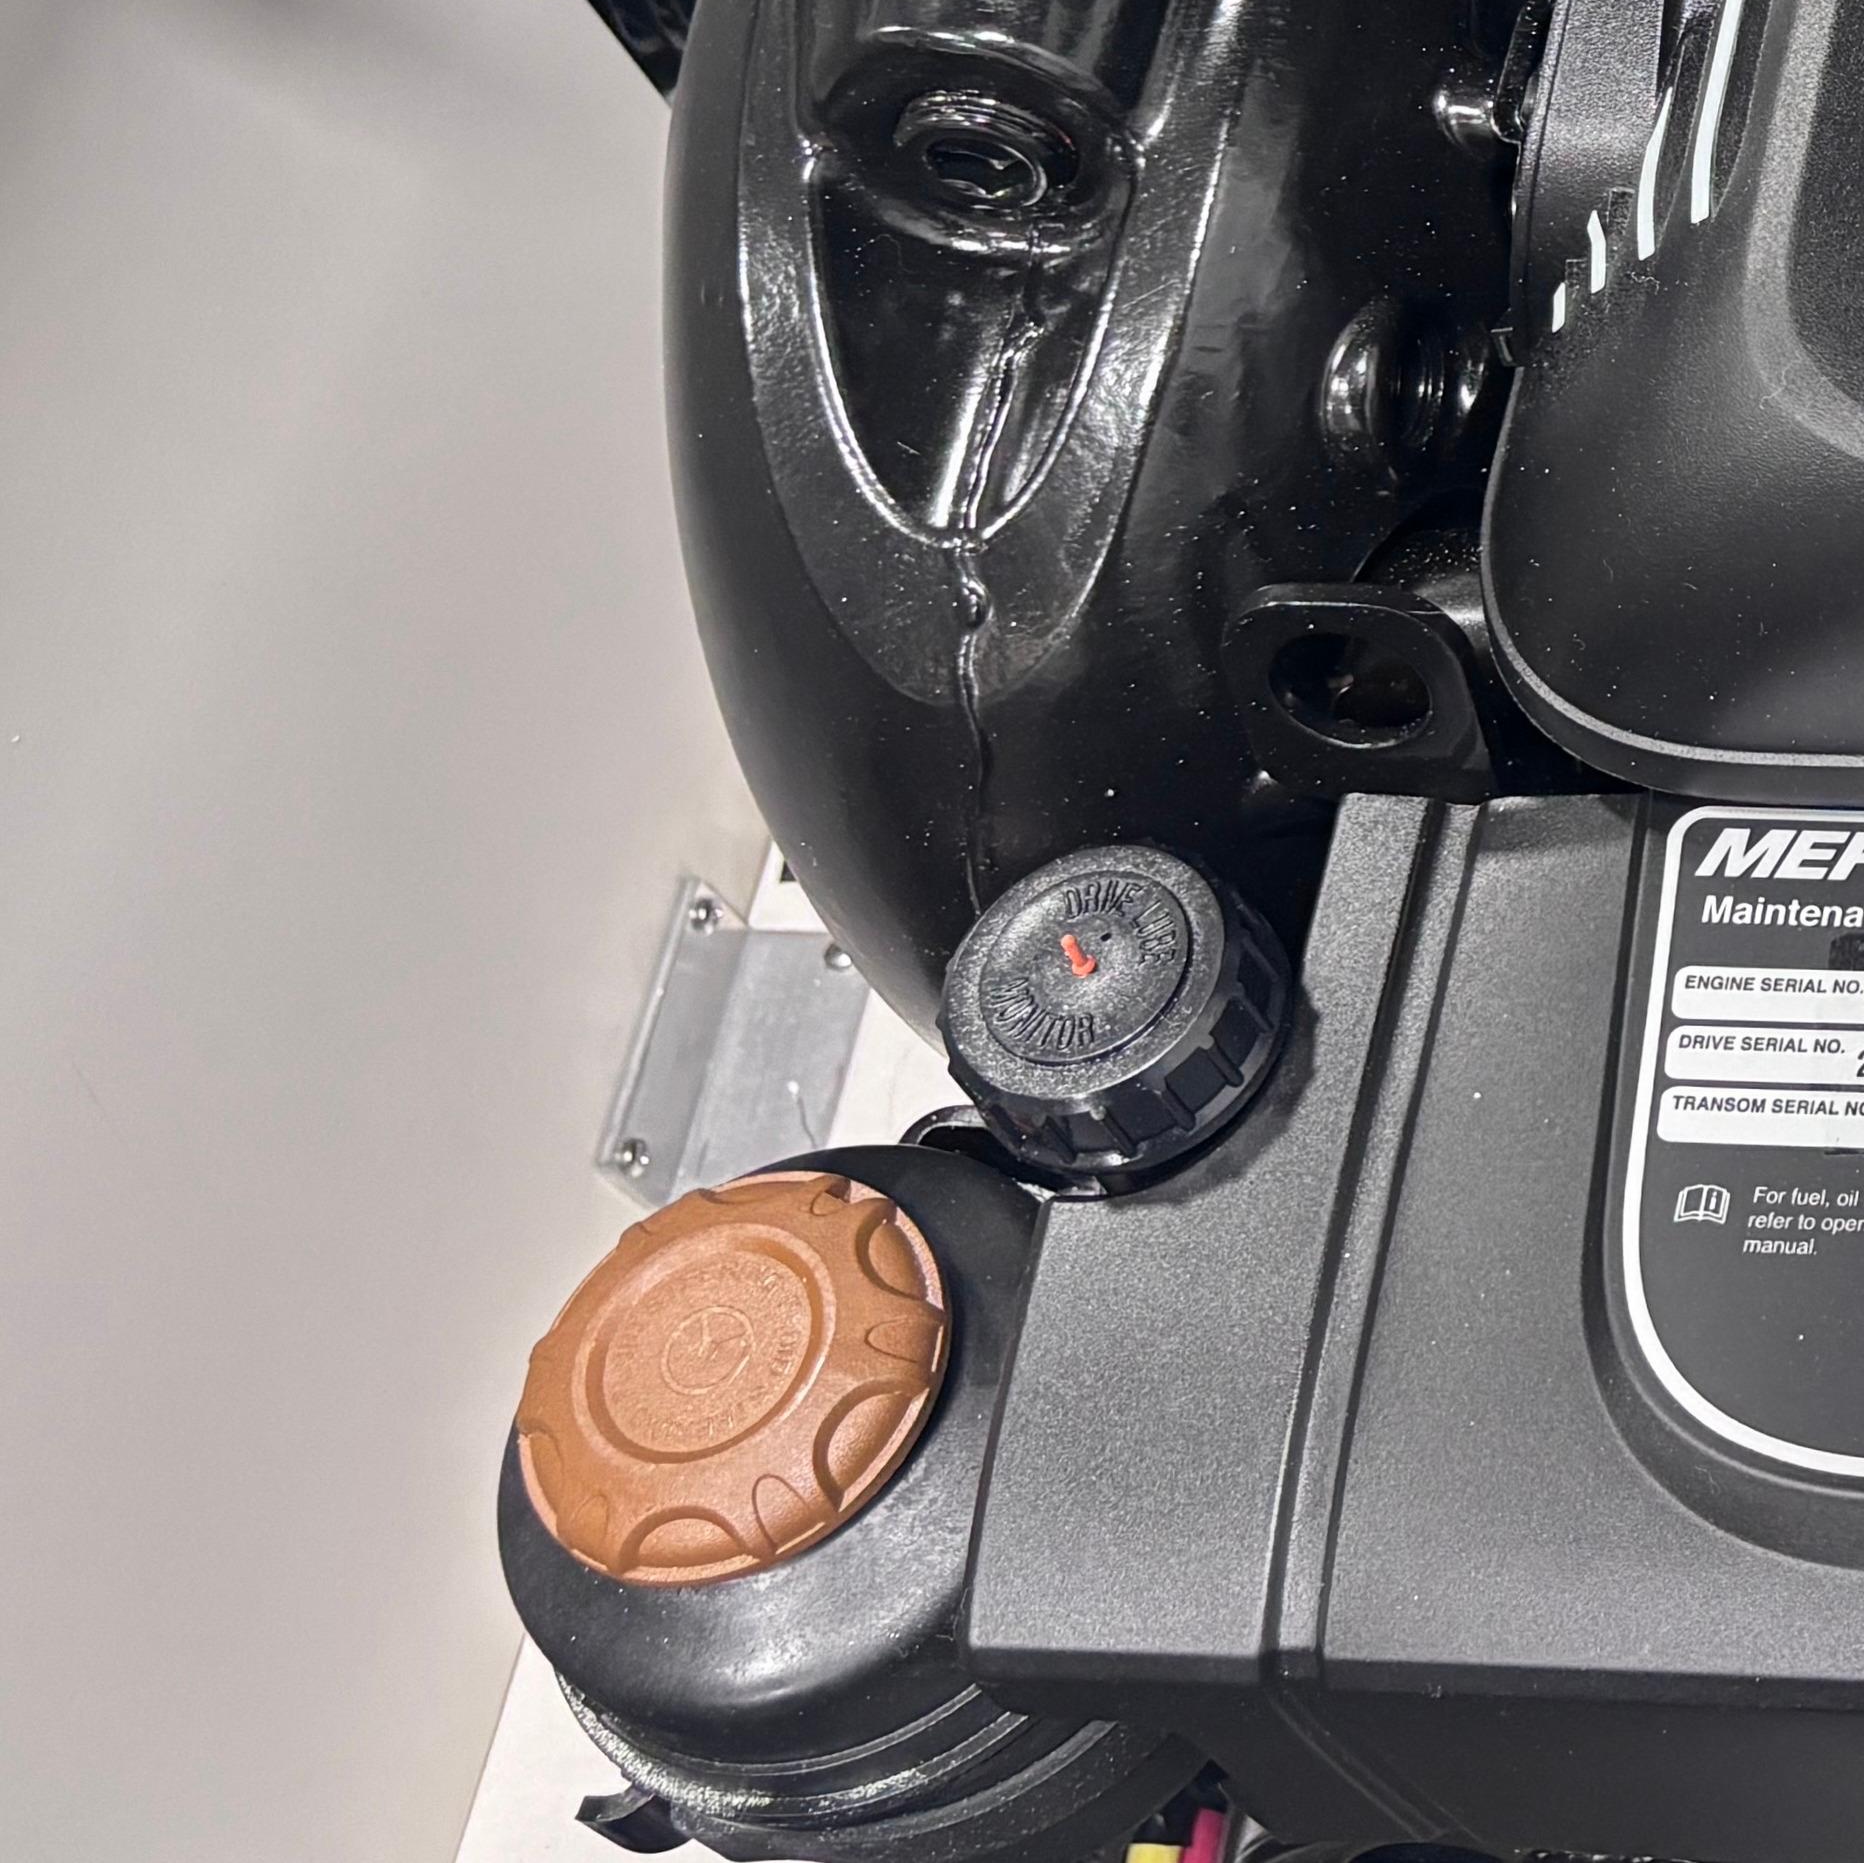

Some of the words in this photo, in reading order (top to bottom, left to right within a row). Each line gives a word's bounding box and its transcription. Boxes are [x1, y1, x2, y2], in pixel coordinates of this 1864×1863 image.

[1063, 880, 1142, 920] DRIVE
[1129, 899, 1176, 965] LUBE
[1684, 974, 1755, 991] ENGINE
[1760, 977, 1827, 993] SERIAL
[1832, 979, 1864, 995] NO.
[991, 977, 1095, 1051] MONITOR
[1678, 1034, 1736, 1050] DRIVE
[1740, 1036, 1807, 1052] SERIAL
[1813, 1038, 1845, 1053] NO.
[1673, 1095, 1766, 1113] TRANSOM
[1771, 1098, 1839, 1115] SERIAL
[1753, 1186, 1786, 1204] For
[1791, 1187, 1829, 1207] fuel,
[1836, 1190, 1859, 1206] oil
